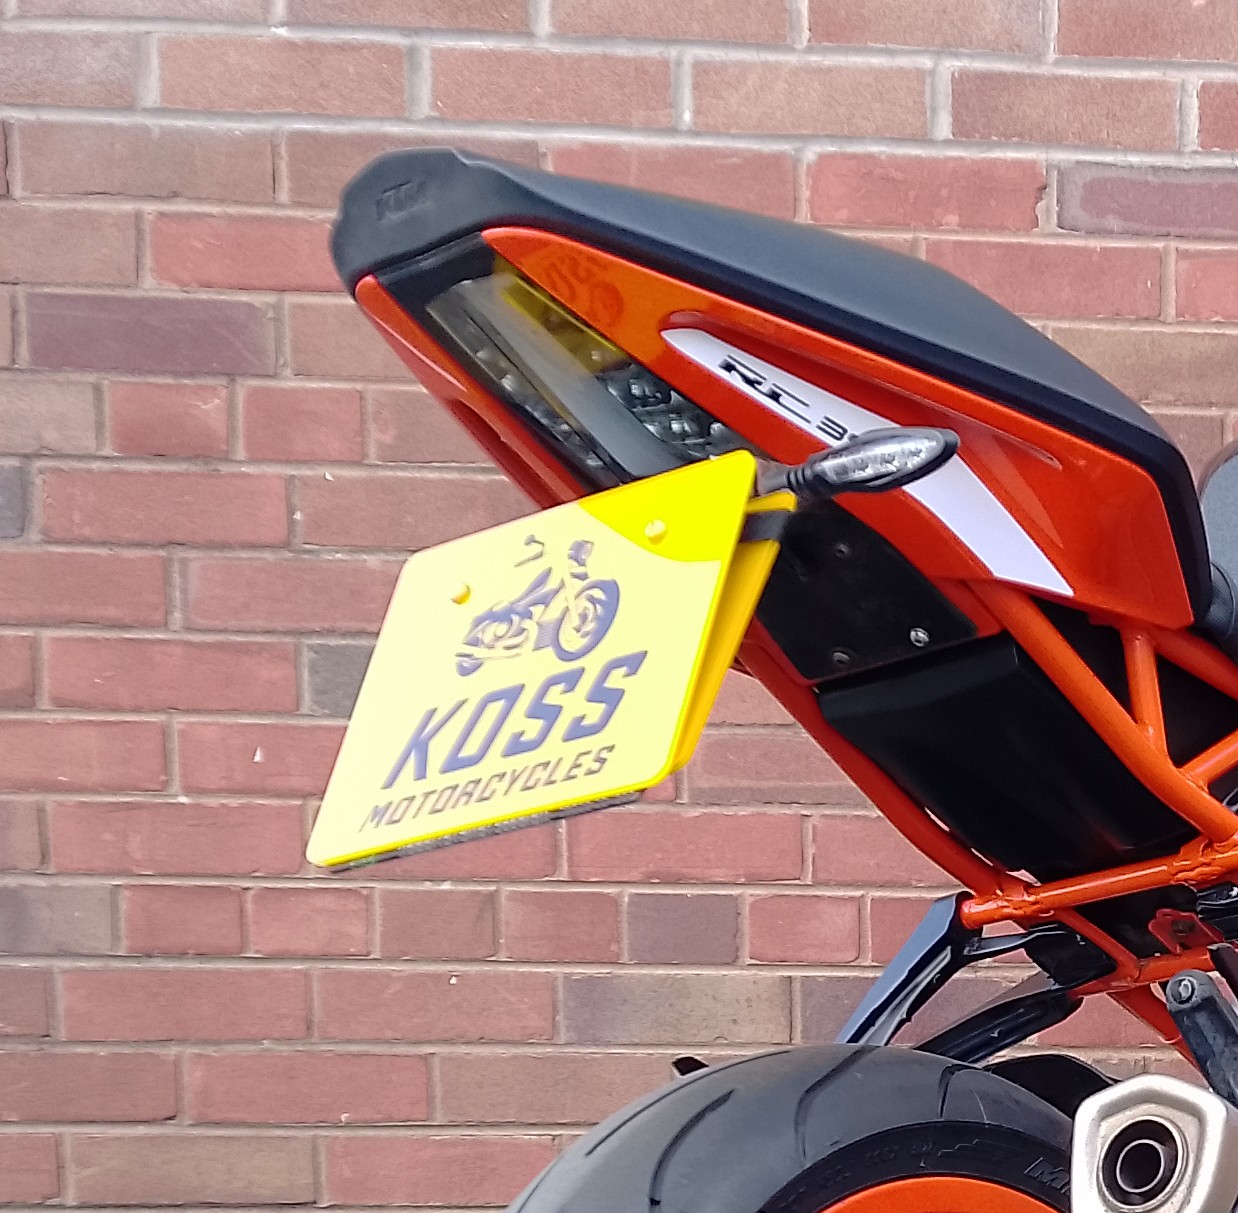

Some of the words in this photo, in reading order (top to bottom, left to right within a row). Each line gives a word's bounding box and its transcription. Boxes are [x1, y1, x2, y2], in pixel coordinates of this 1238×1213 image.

[717, 354, 812, 424] RC
[381, 650, 648, 789] KOSS
[358, 744, 616, 832] MOTORCYCLES
